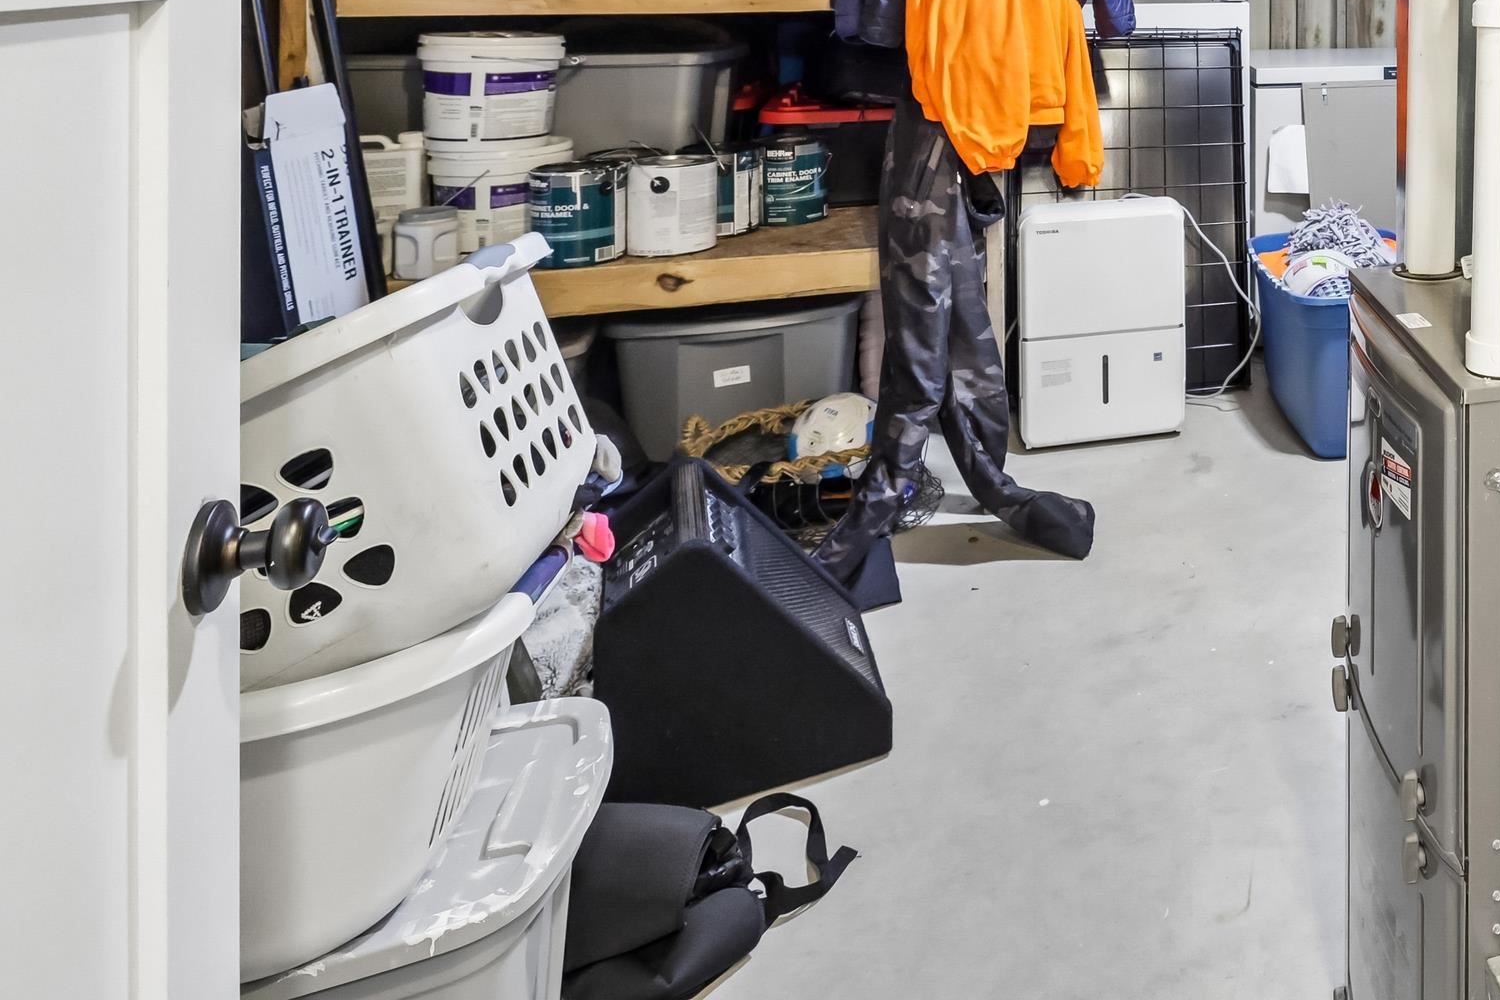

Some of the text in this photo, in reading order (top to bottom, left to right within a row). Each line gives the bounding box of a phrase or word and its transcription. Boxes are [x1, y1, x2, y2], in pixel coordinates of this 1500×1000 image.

[261, 165, 272, 190] PERFECT
[785, 175, 813, 183] ENAMEL
[266, 190, 274, 202] FOR
[320, 148, 345, 204] 2-IN-1
[334, 206, 358, 281] TRAINER
[277, 252, 285, 265] AND
[280, 265, 290, 291] PITCHING
[285, 291, 293, 311] DRILLS
